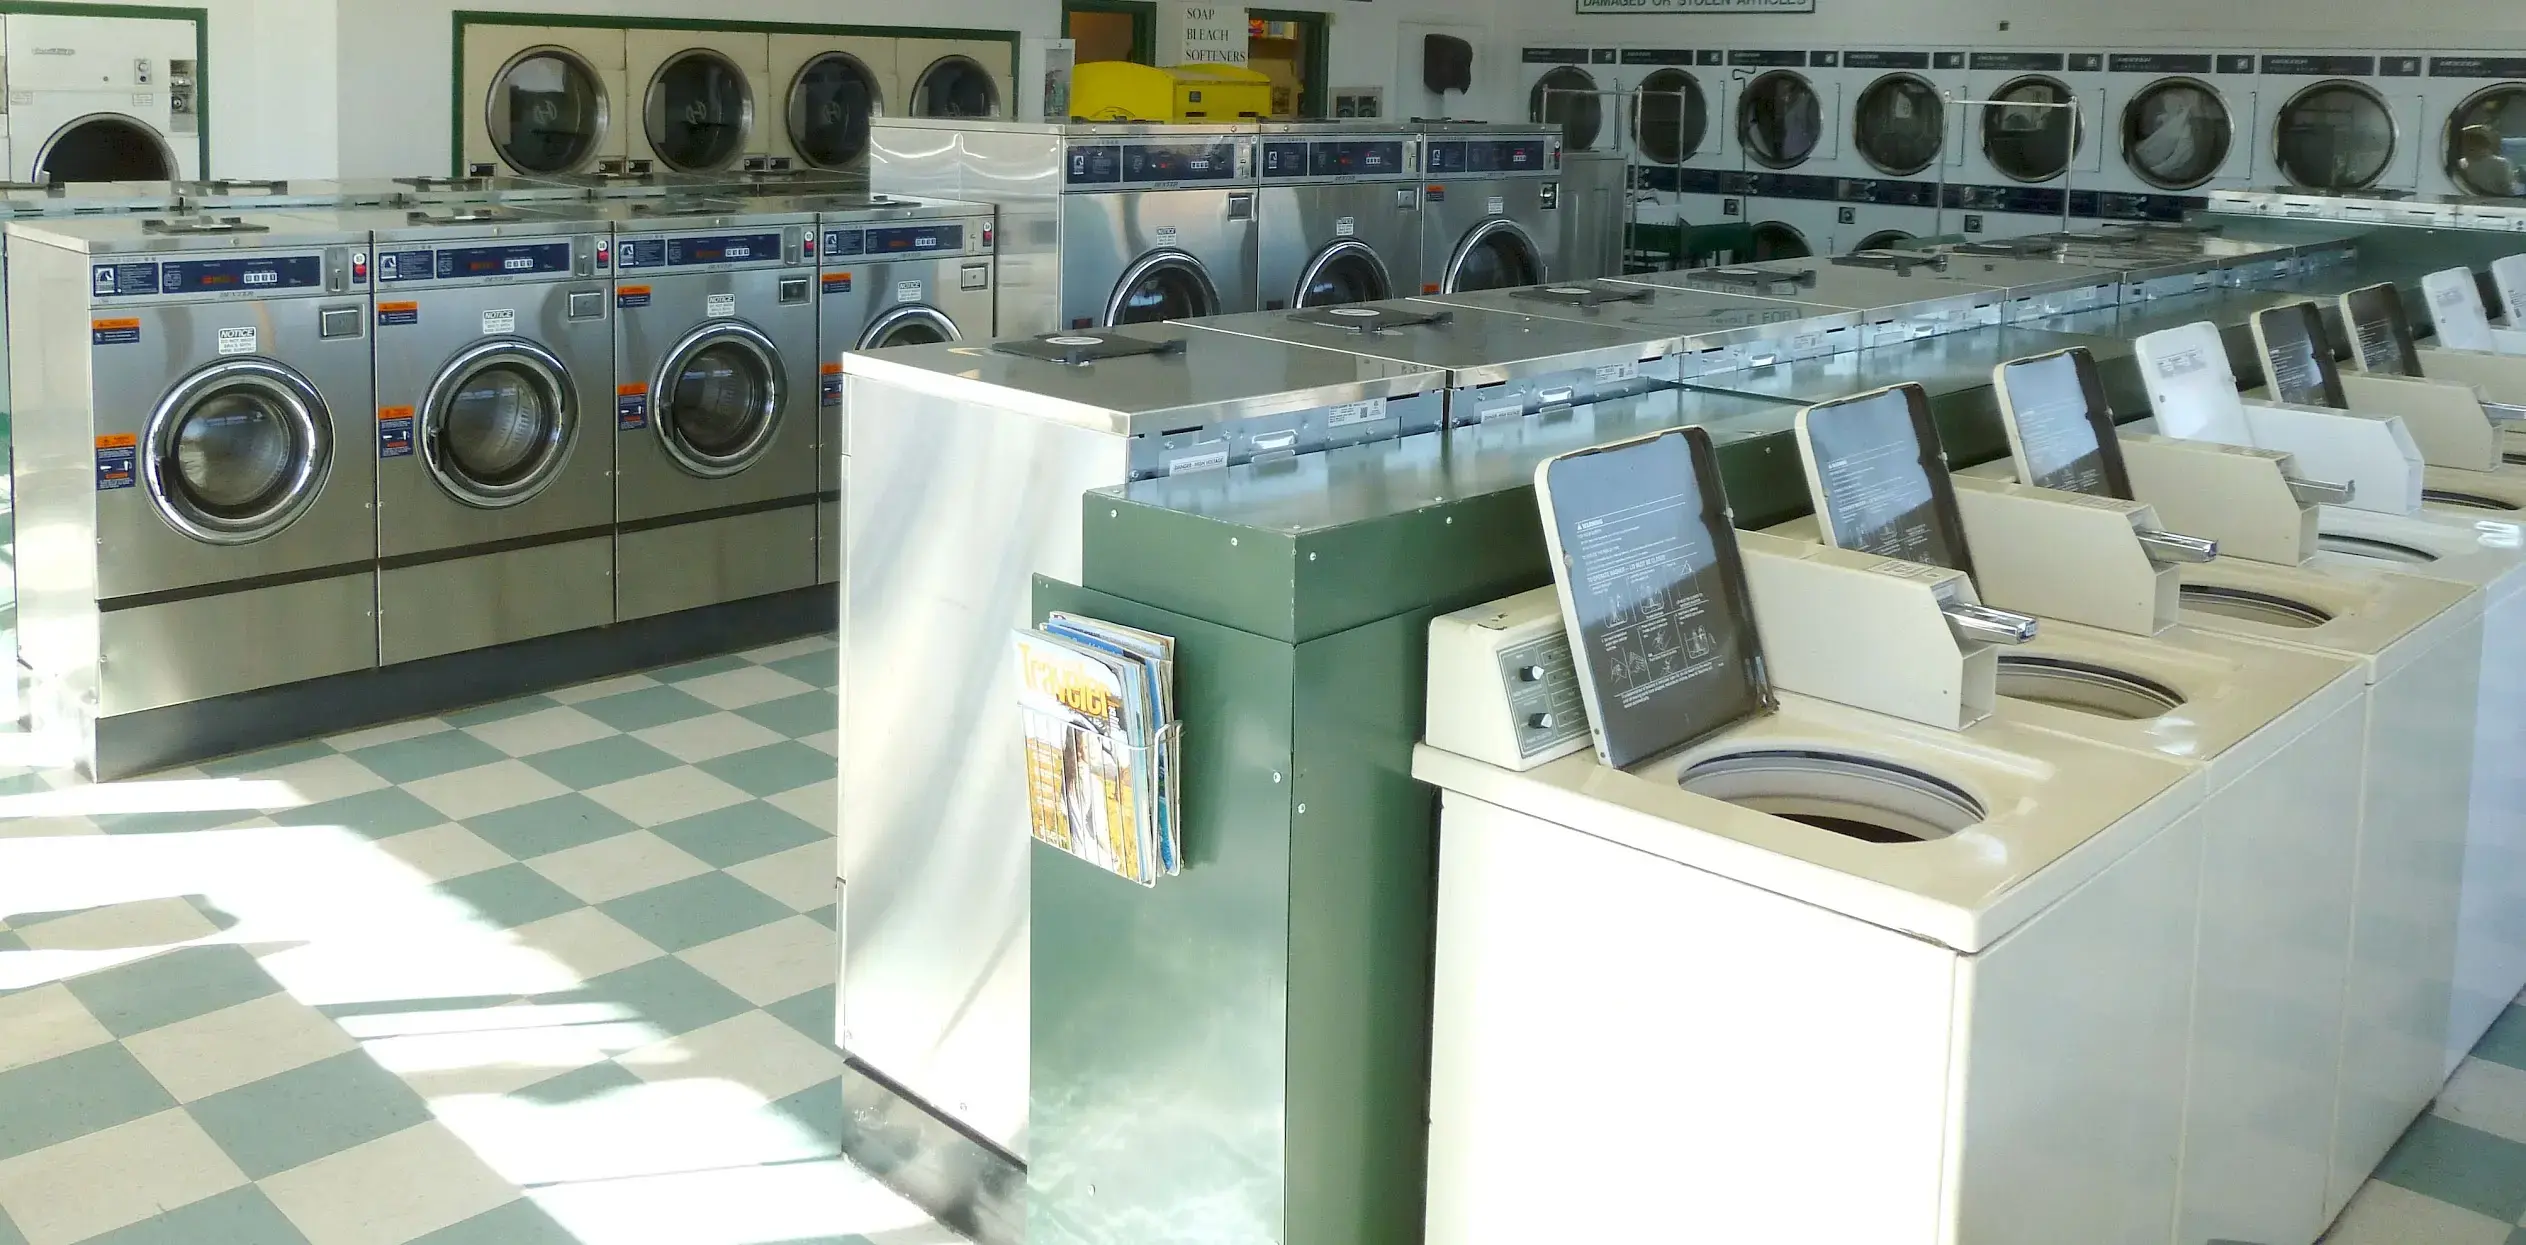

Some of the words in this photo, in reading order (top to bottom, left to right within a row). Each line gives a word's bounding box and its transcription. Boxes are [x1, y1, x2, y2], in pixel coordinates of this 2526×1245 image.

[1187, 8, 1215, 20] SOAP
[1187, 28, 1229, 41] BLEACH
[1185, 48, 1246, 62] SOFTENERS
[899, 282, 920, 290] NOTICE
[485, 310, 512, 318] NOTICE
[220, 330, 253, 338] NOTICE
[1018, 642, 1112, 719] Traveler
